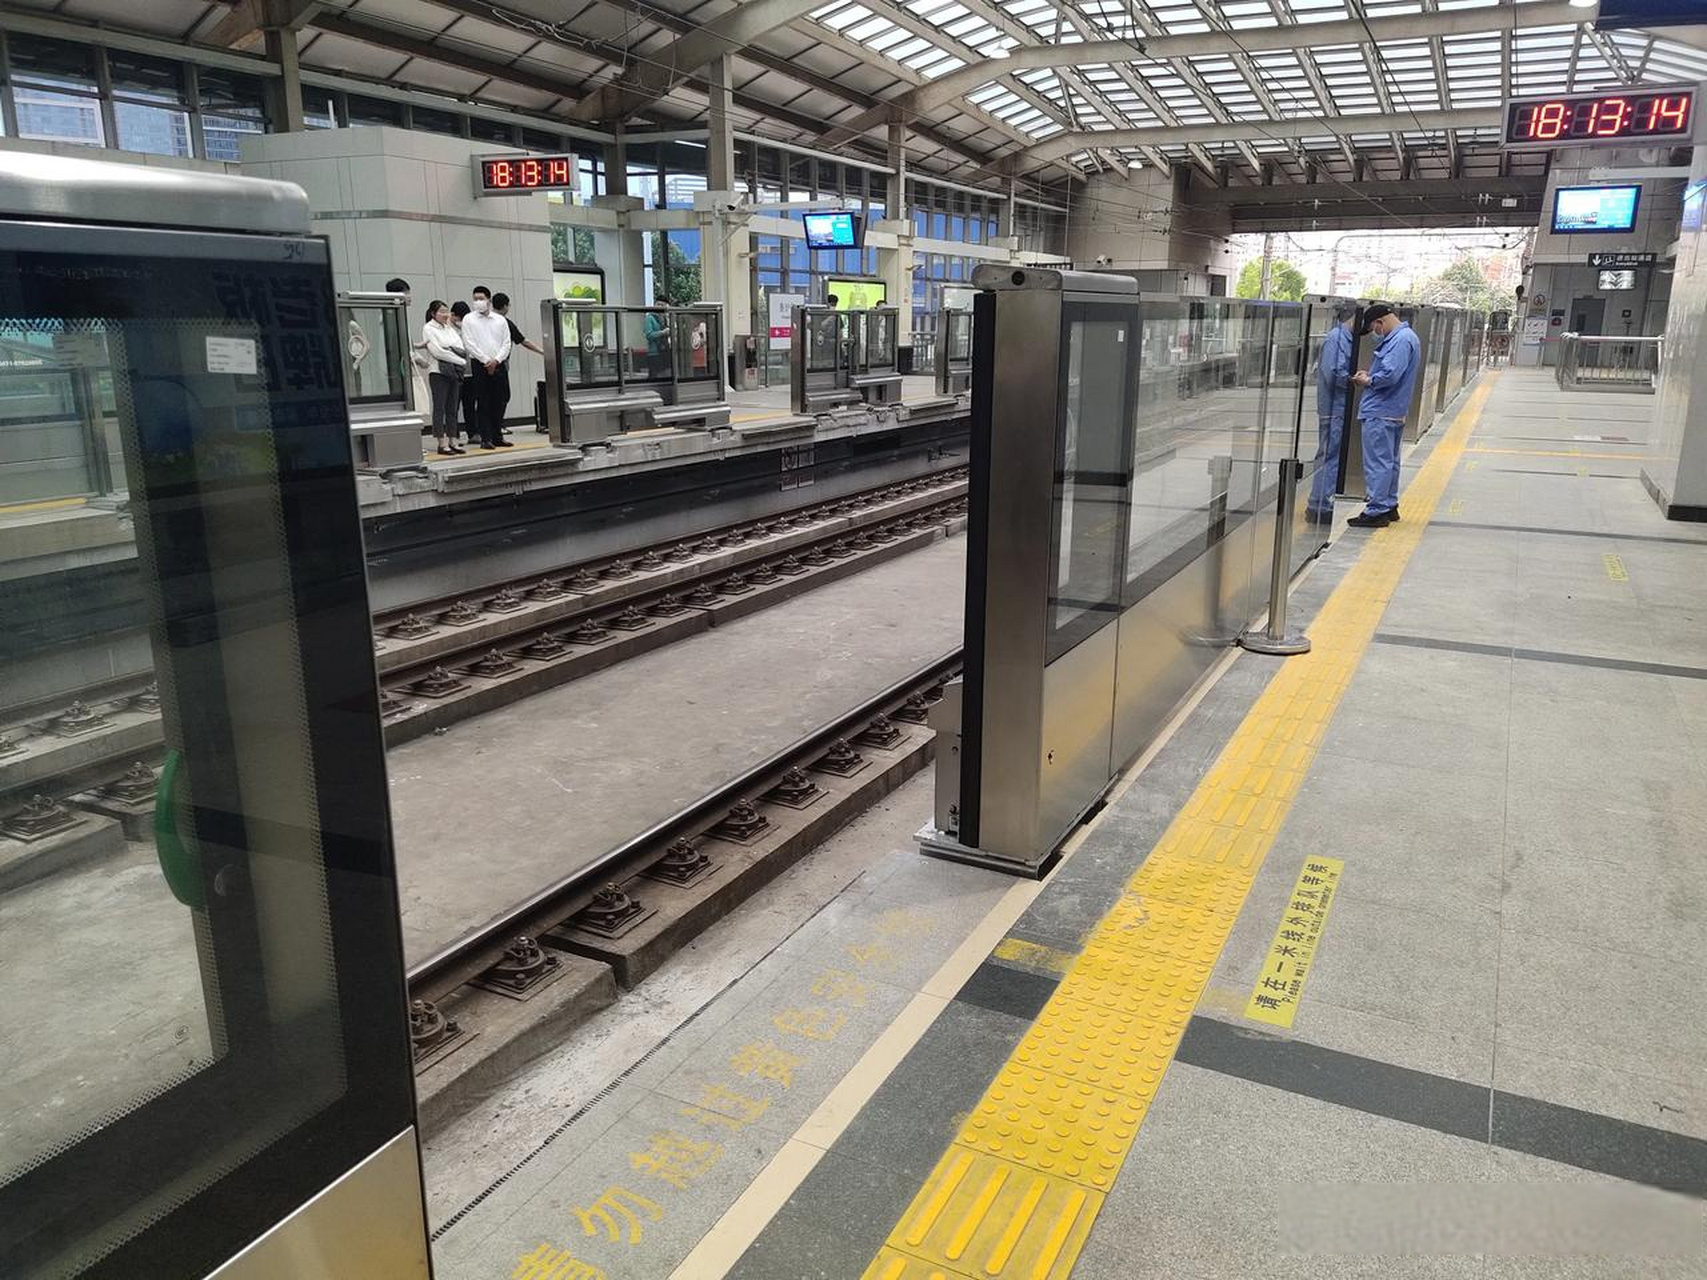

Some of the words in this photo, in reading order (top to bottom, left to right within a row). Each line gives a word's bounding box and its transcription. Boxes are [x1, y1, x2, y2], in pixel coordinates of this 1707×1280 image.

[1528, 97, 1688, 138] 18:13:14
[492, 160, 568, 188] 18:13:14
[1282, 980, 1302, 1003] Please
[1294, 961, 1308, 976] wait
